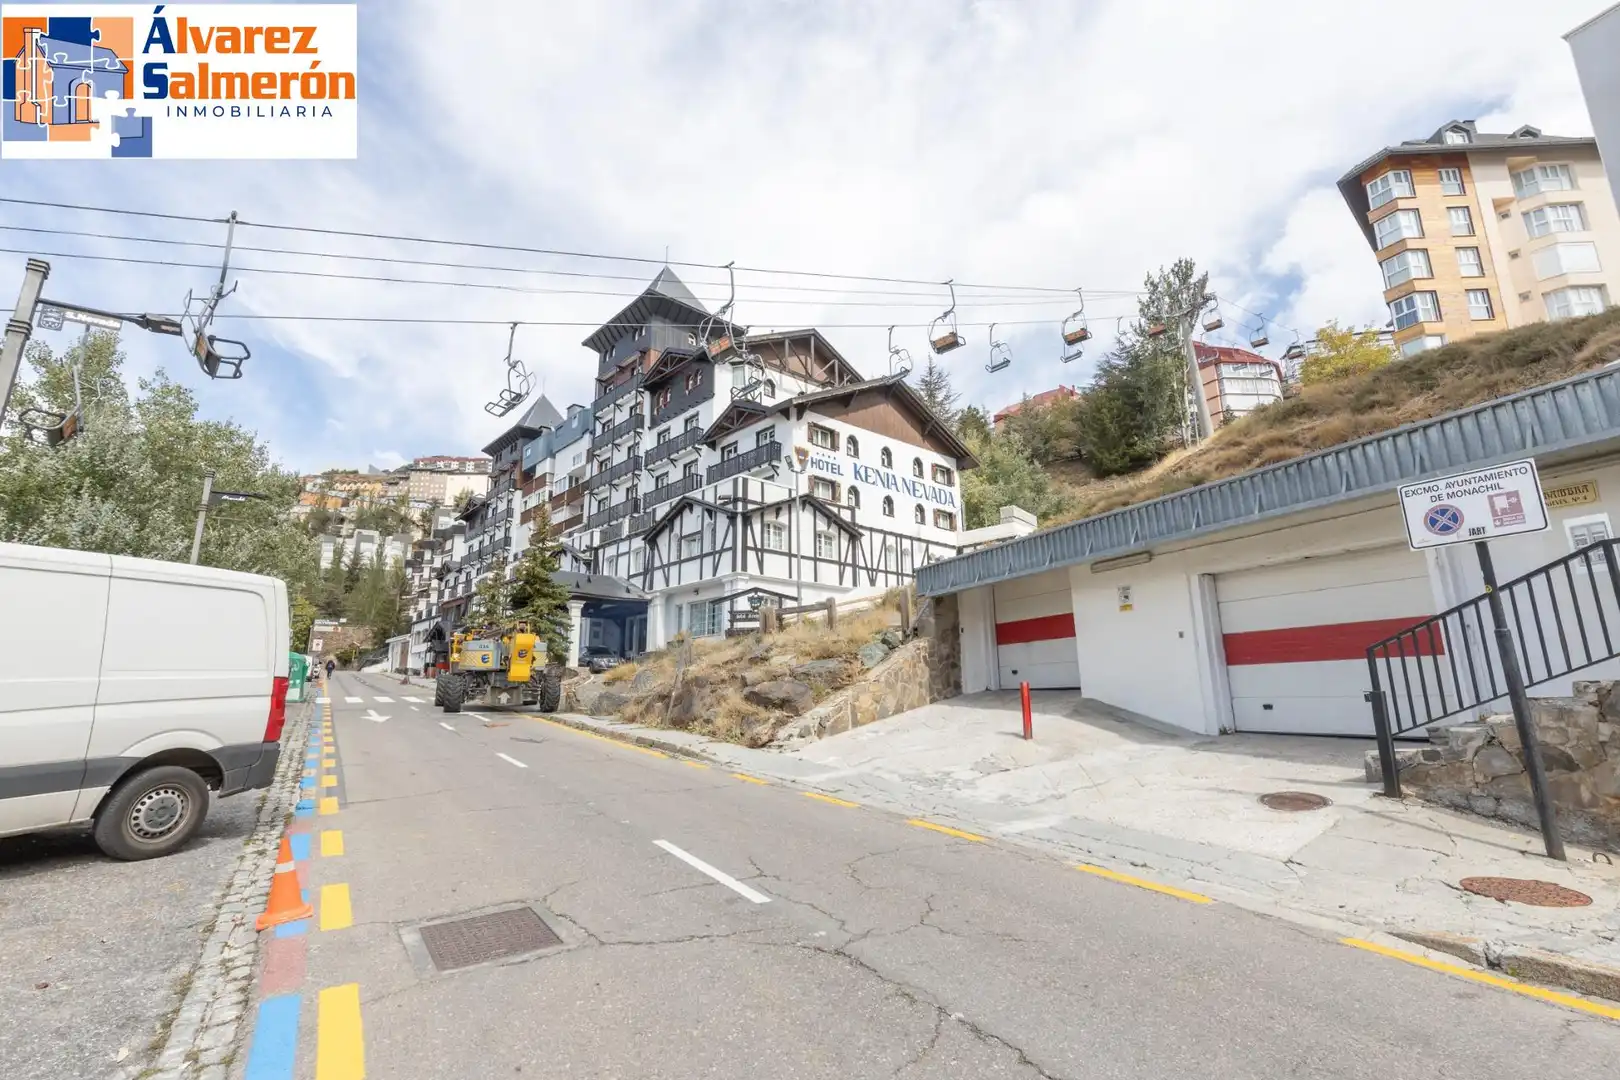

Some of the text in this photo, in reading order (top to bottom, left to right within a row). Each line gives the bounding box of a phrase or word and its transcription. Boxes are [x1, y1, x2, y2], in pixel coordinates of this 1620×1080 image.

[810, 456, 957, 508] HOTEL KENIA NEVADA
[1404, 466, 1528, 498] EXCMO. AYUNTAMIENTO
[1430, 483, 1504, 504] DE MONACHIL
